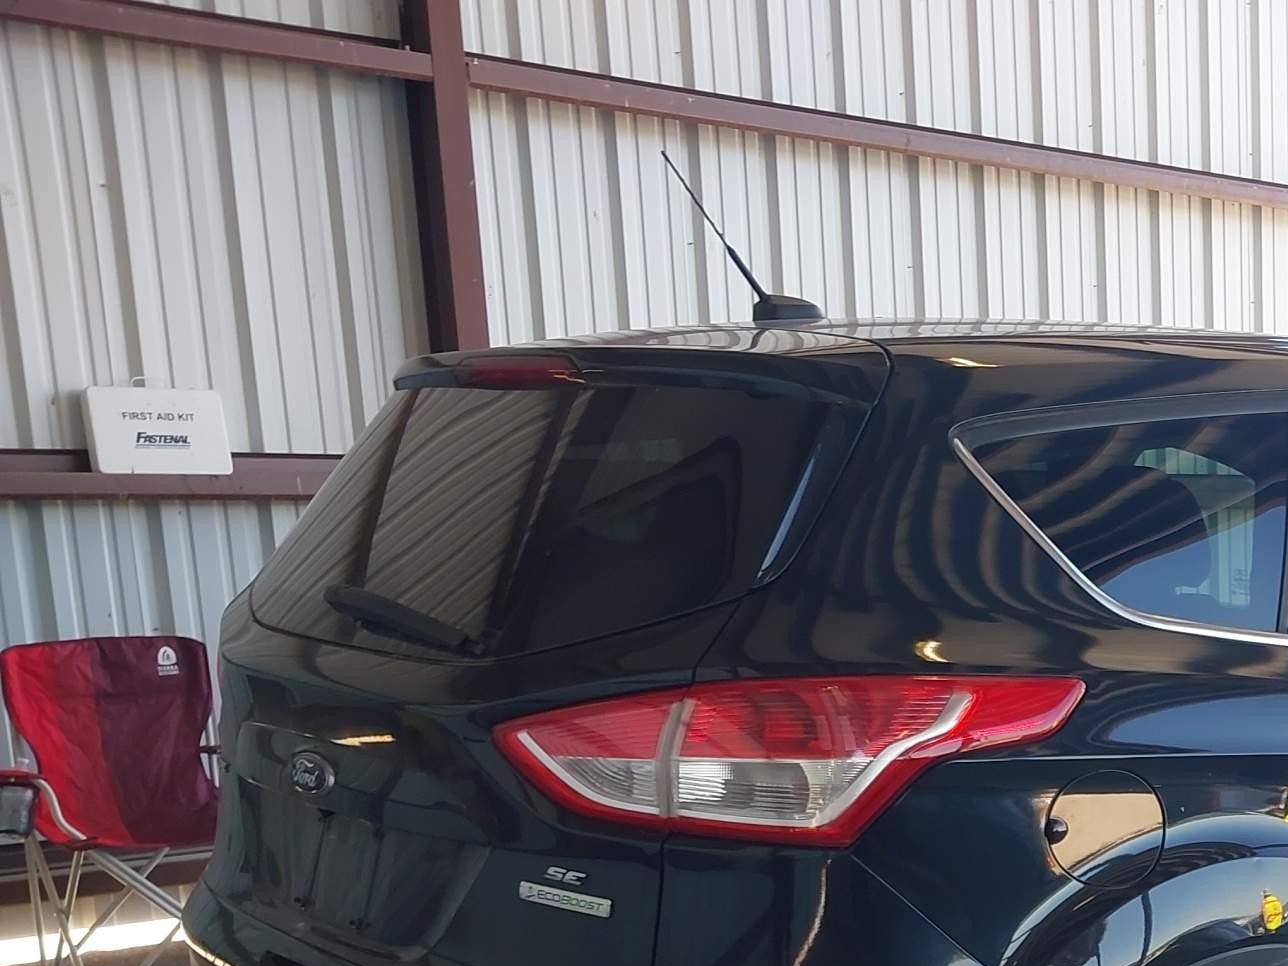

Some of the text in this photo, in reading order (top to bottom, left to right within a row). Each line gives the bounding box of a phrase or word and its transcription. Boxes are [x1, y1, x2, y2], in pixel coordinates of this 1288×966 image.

[121, 411, 196, 422] FIRST AID KIT
[292, 758, 320, 787] Ford
[543, 865, 588, 886] SE
